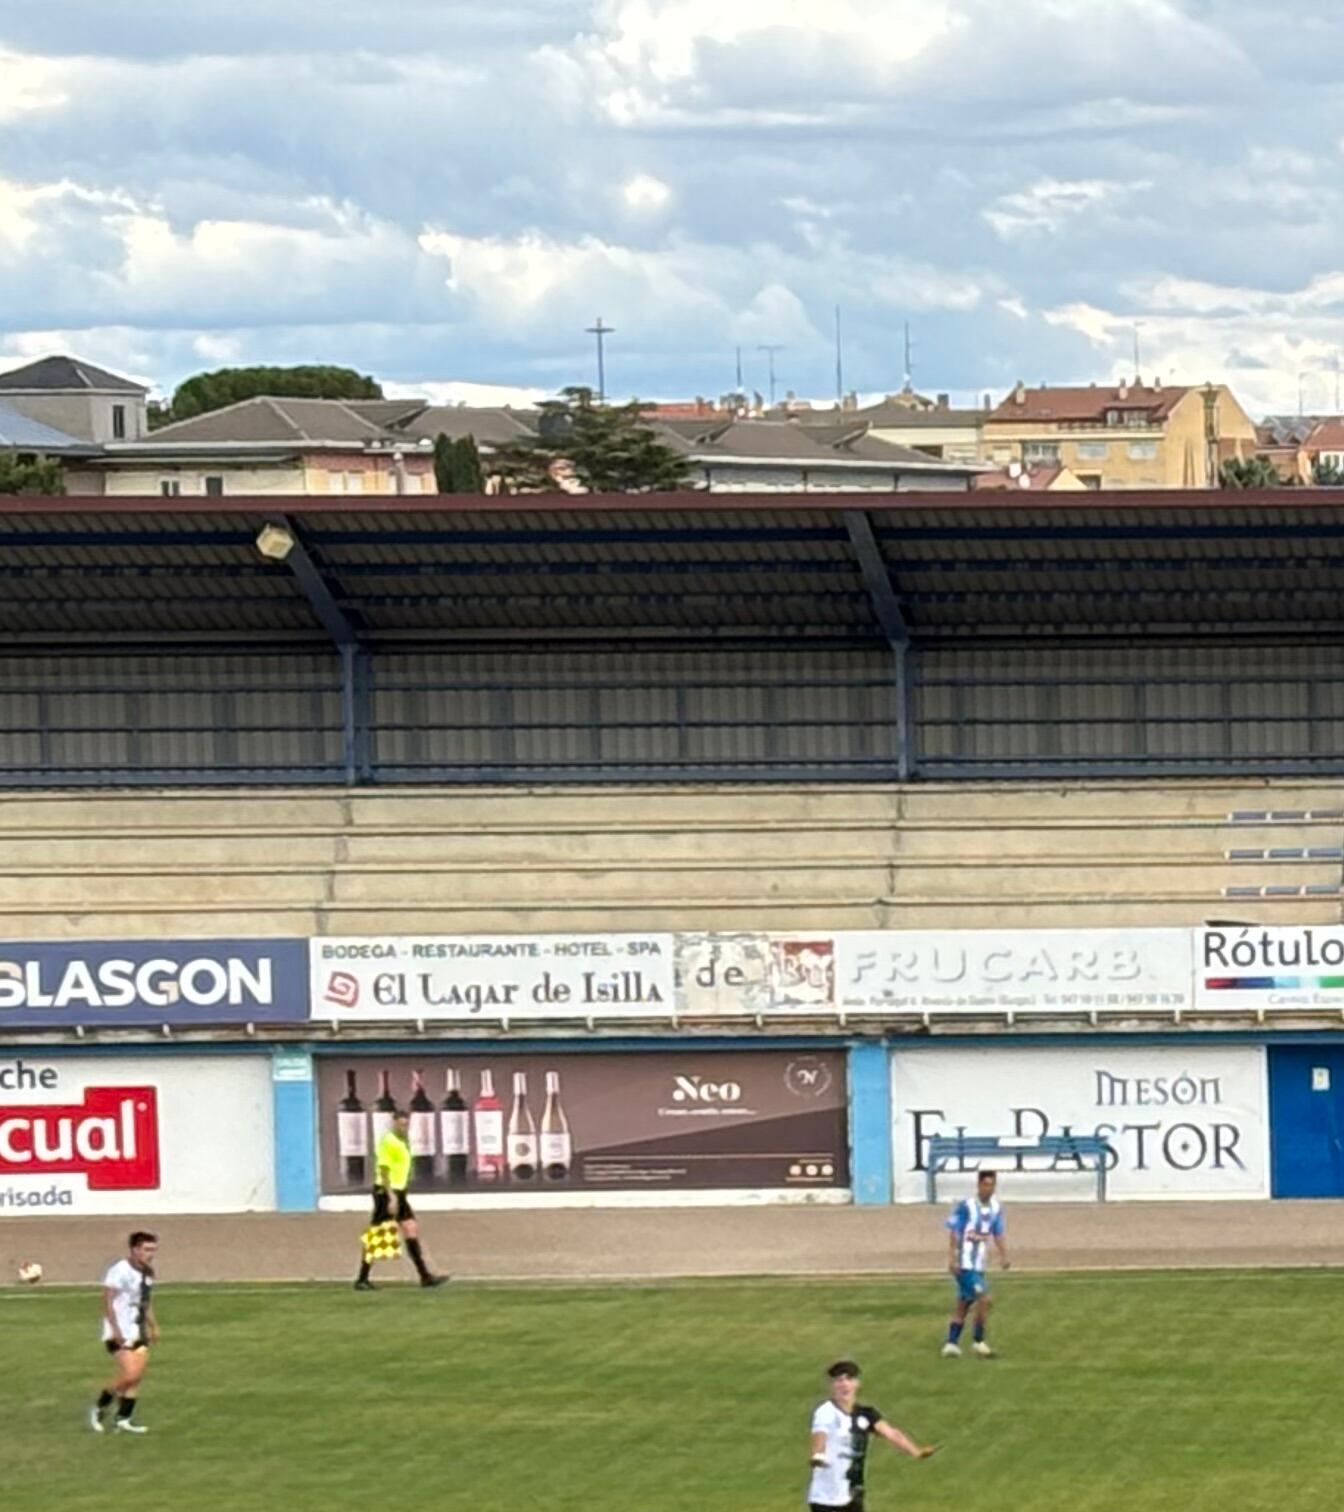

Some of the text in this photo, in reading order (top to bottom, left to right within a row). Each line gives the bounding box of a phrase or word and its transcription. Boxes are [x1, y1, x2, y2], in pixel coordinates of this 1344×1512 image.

[322, 941, 662, 960] BODEGA RESTAURANTE HOTEL SPA
[851, 948, 1143, 984] FRUCARB
[373, 973, 408, 1006] El
[532, 972, 571, 1004] de
[581, 970, 665, 1004] Isilla
[0, 1060, 58, 1089] che
[672, 1076, 741, 1101] Neo
[0, 1099, 136, 1162] cual
